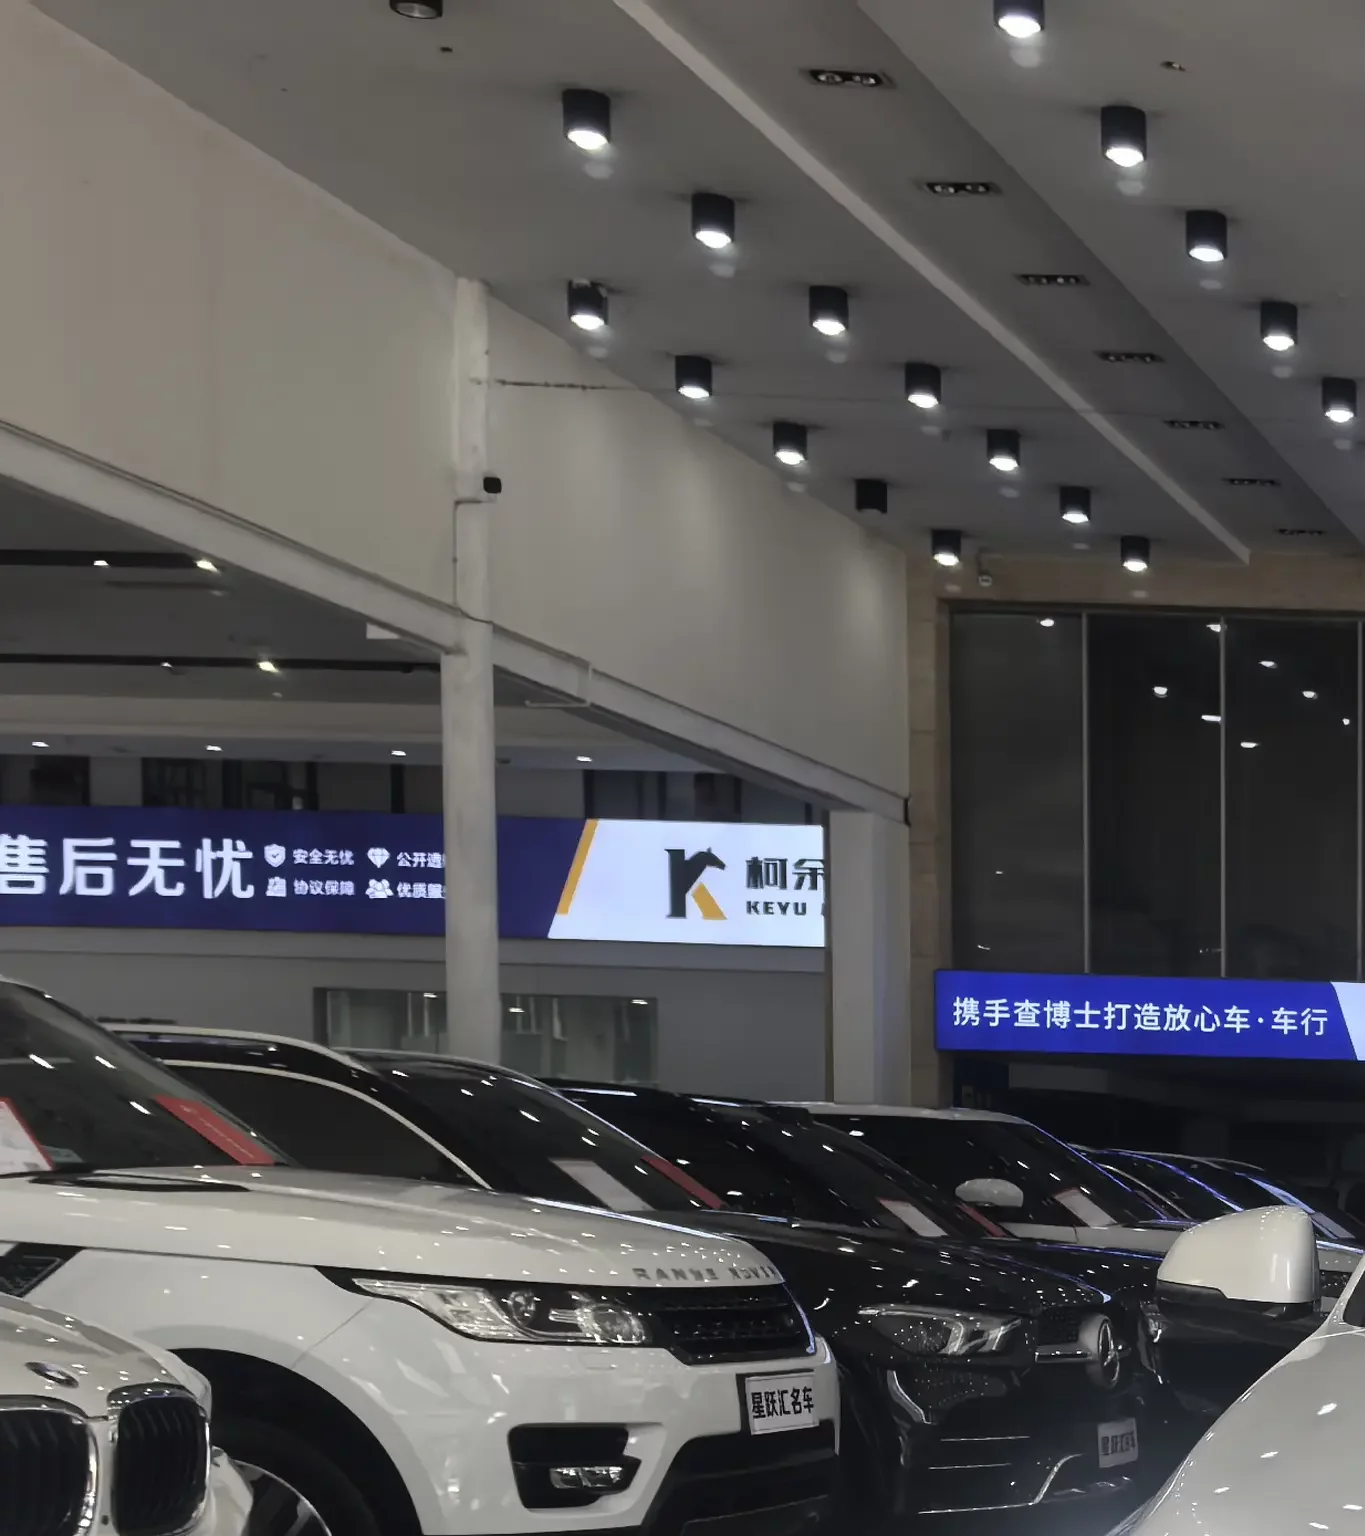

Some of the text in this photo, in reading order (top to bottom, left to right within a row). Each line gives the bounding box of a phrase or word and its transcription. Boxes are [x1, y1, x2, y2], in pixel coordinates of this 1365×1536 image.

[0, 833, 254, 899] 售后无忧
[746, 901, 807, 916] KEYU
[953, 996, 1328, 1036] 携手查博士打造放心车·车行
[751, 1386, 814, 1419] 星跃汇名车
